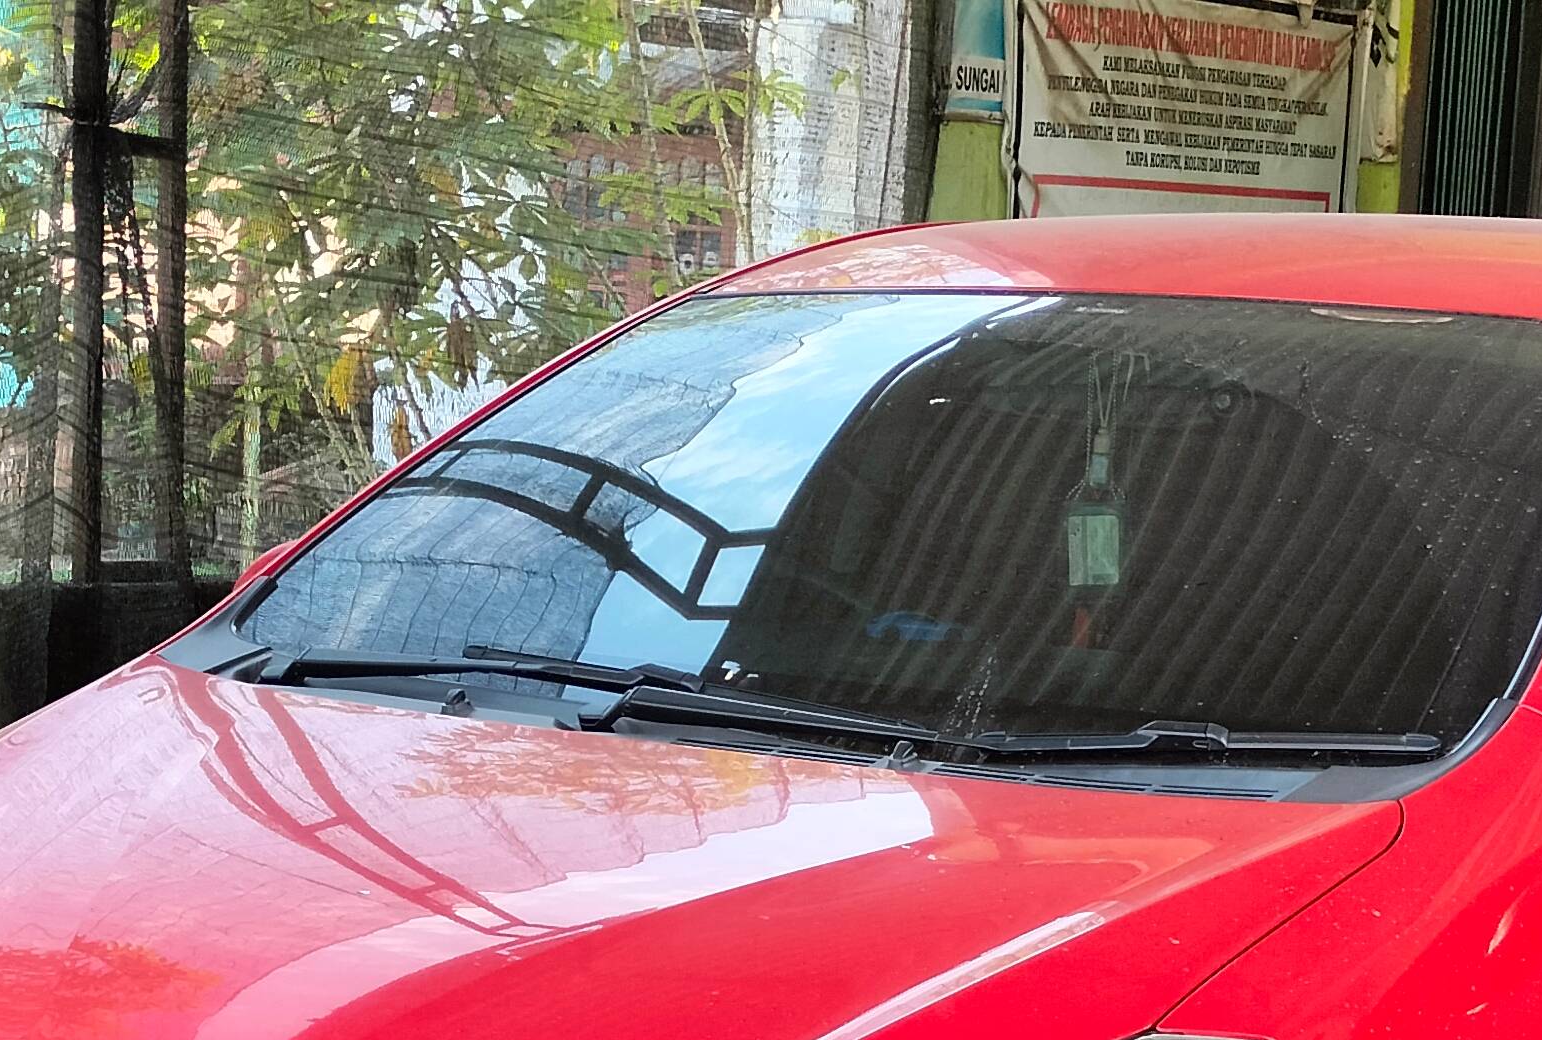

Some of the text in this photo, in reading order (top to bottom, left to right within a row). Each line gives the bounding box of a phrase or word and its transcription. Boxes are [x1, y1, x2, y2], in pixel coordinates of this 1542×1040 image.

[955, 65, 1000, 93] SUNGAI
[1103, 55, 1121, 72] KAMI
[1123, 57, 1180, 79] MELAKSANAKAN
[1207, 67, 1251, 87] PENGAWASAN
[1252, 73, 1287, 91] TERHADAP
[1110, 79, 1139, 97] NEGARA
[1141, 82, 1157, 99] DAN
[1224, 91, 1241, 108] PADA
[1243, 93, 1265, 111] SEMUA
[1089, 101, 1297, 135] ARAH KEBIJAKAN UNTUK MENERUSKAN ASPIRASI MASYARAKAT
[1034, 121, 1337, 160] KEPADA PEMERINTAH SERTA MENGAWAL KEBIJAKAN PEMERINTAH HINGGA TEPAT SASARAN
[1126, 151, 1148, 167] TANPA
[1184, 155, 1207, 172] KOLUSI
[1209, 157, 1222, 173] DAN
[1224, 159, 1260, 175] NEPOTISME
